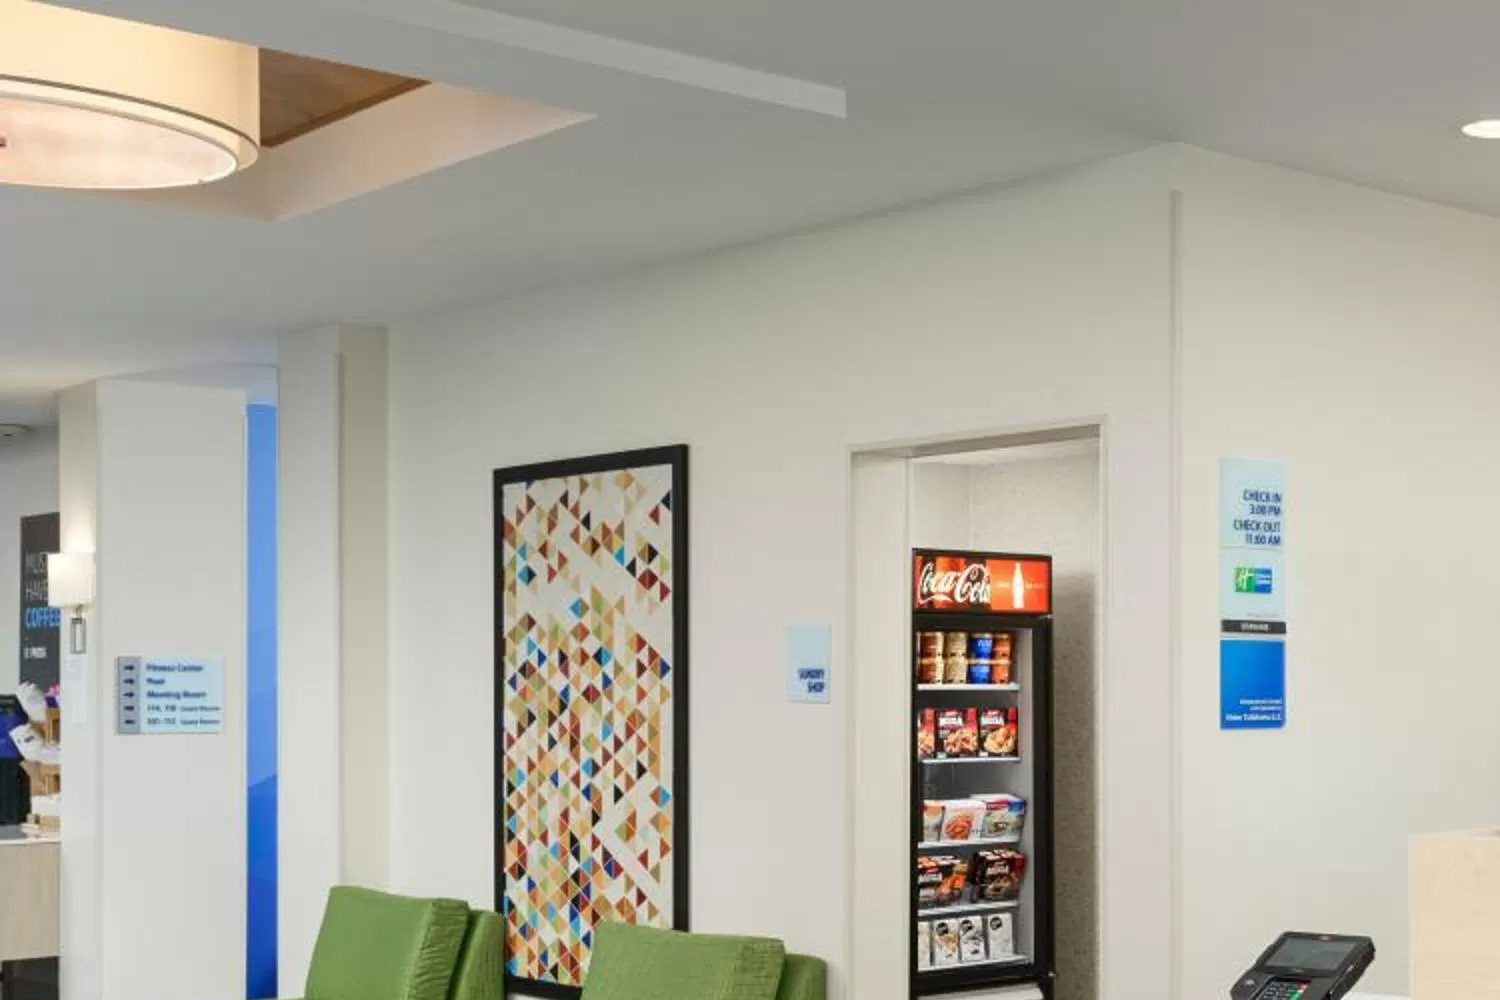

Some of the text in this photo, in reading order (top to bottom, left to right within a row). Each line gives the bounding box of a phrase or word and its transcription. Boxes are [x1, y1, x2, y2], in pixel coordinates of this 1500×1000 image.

[1243, 489, 1282, 503] CHECK IN
[1267, 504, 1281, 516] PM
[1233, 519, 1281, 532] CHECK OUT
[1267, 535, 1281, 545] AM
